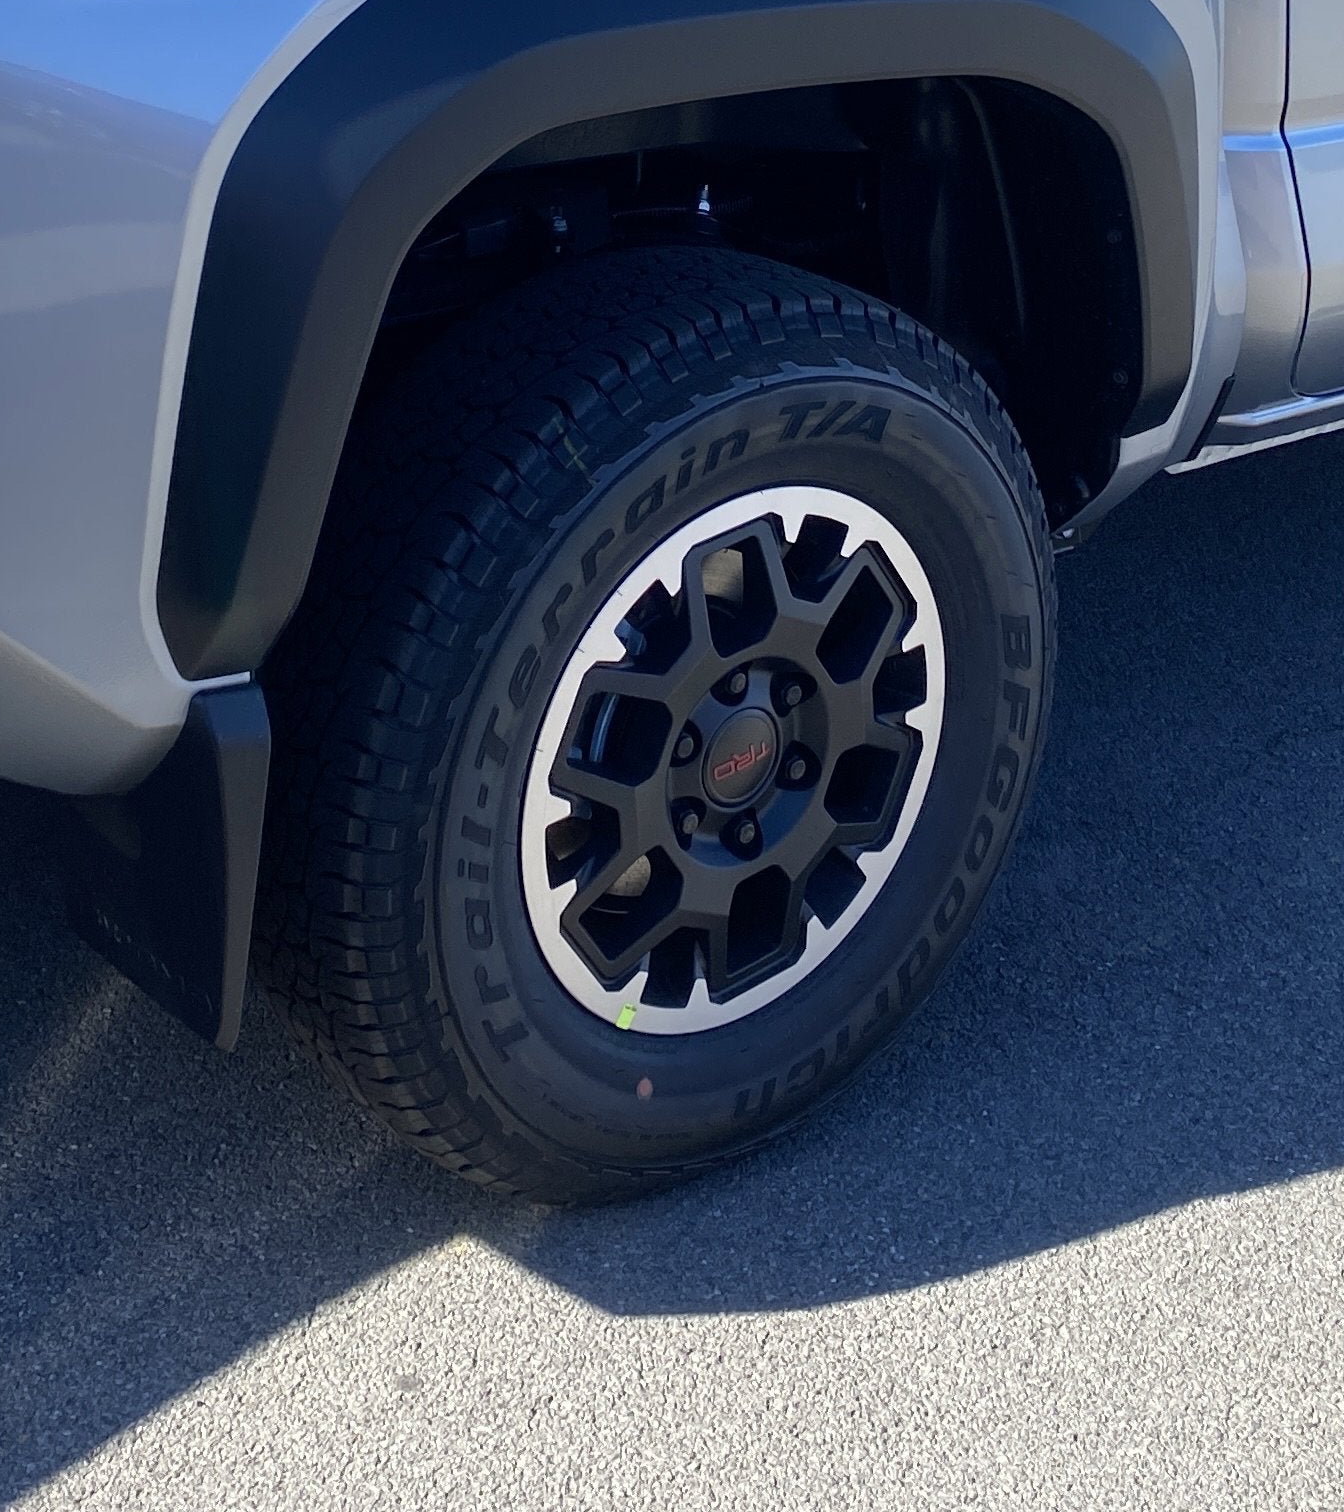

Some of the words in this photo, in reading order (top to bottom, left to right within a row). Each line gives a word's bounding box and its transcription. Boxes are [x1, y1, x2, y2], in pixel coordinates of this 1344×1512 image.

[457, 424, 749, 1064] Trail-Terrain
[776, 399, 892, 444] T/A
[713, 739, 771, 782] TRD
[732, 612, 1032, 1125] BFGoodrich
